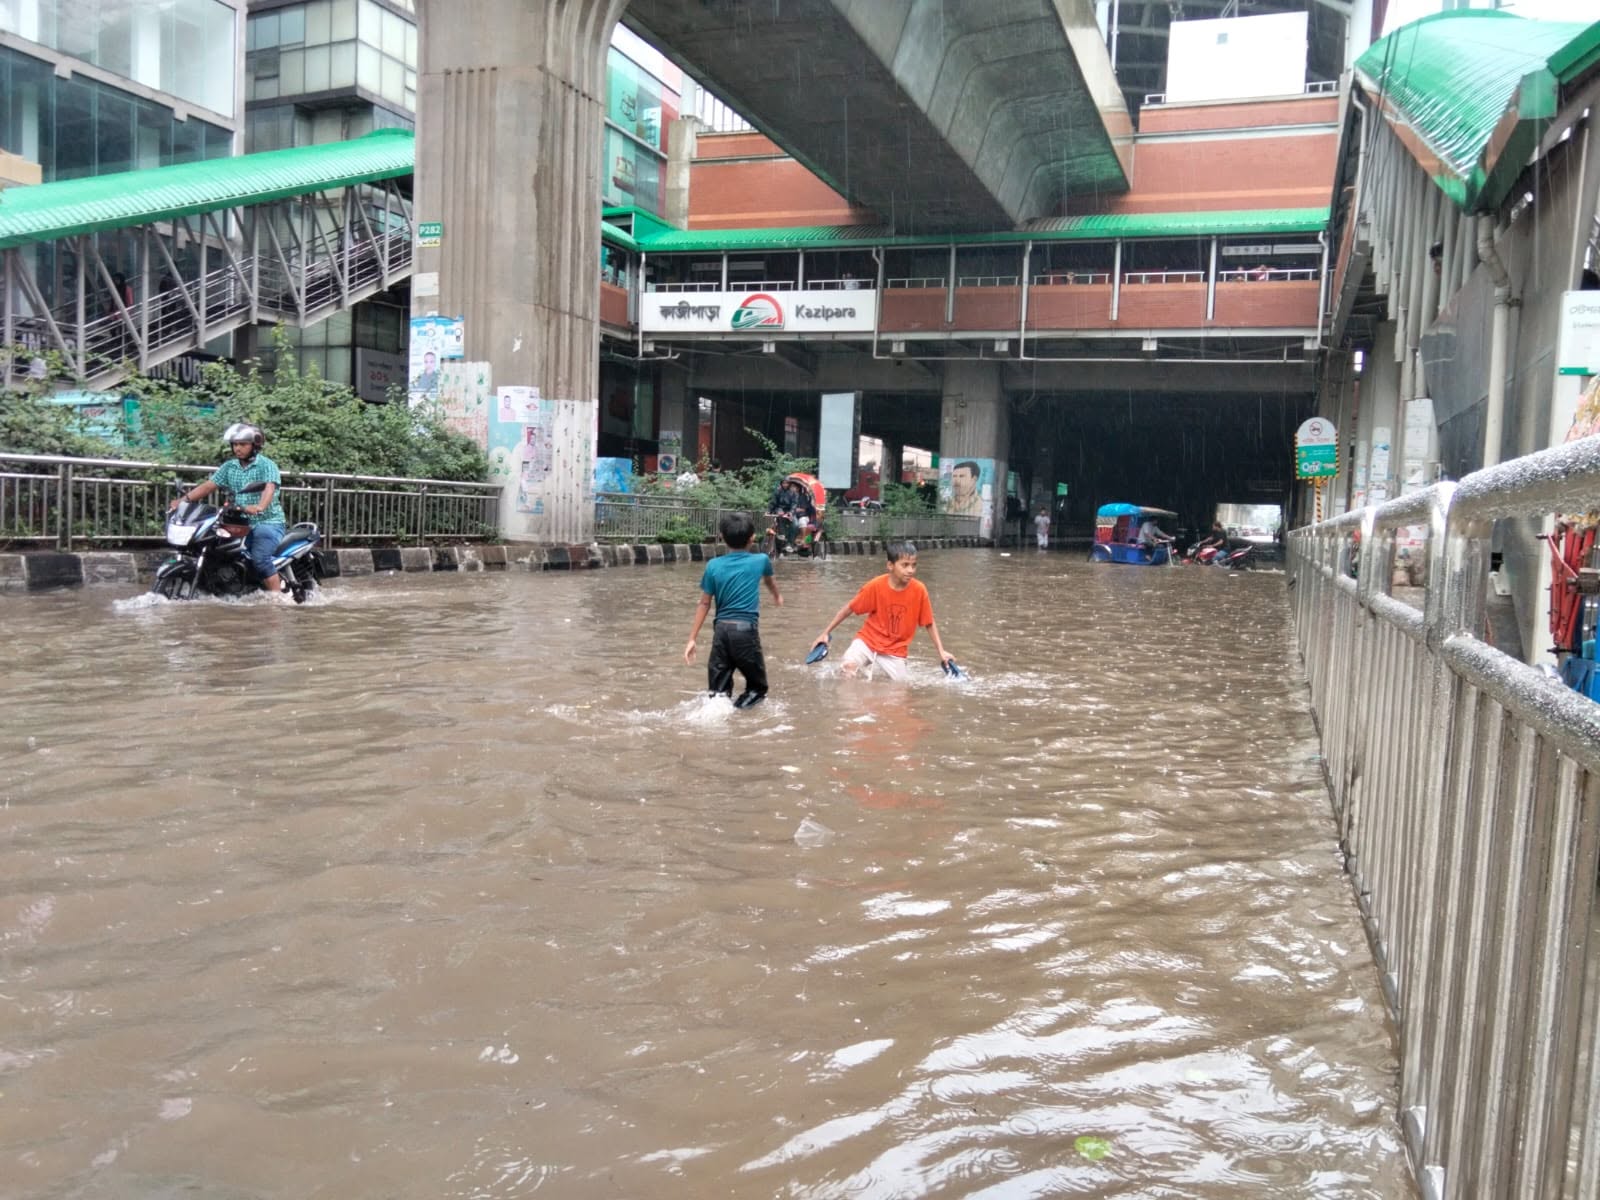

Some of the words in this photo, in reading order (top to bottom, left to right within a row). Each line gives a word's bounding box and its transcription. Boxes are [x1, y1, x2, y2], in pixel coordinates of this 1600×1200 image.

[419, 224, 441, 235] P282
[658, 299, 721, 322] কাজীপাড়া
[795, 303, 856, 321] Kazipara
